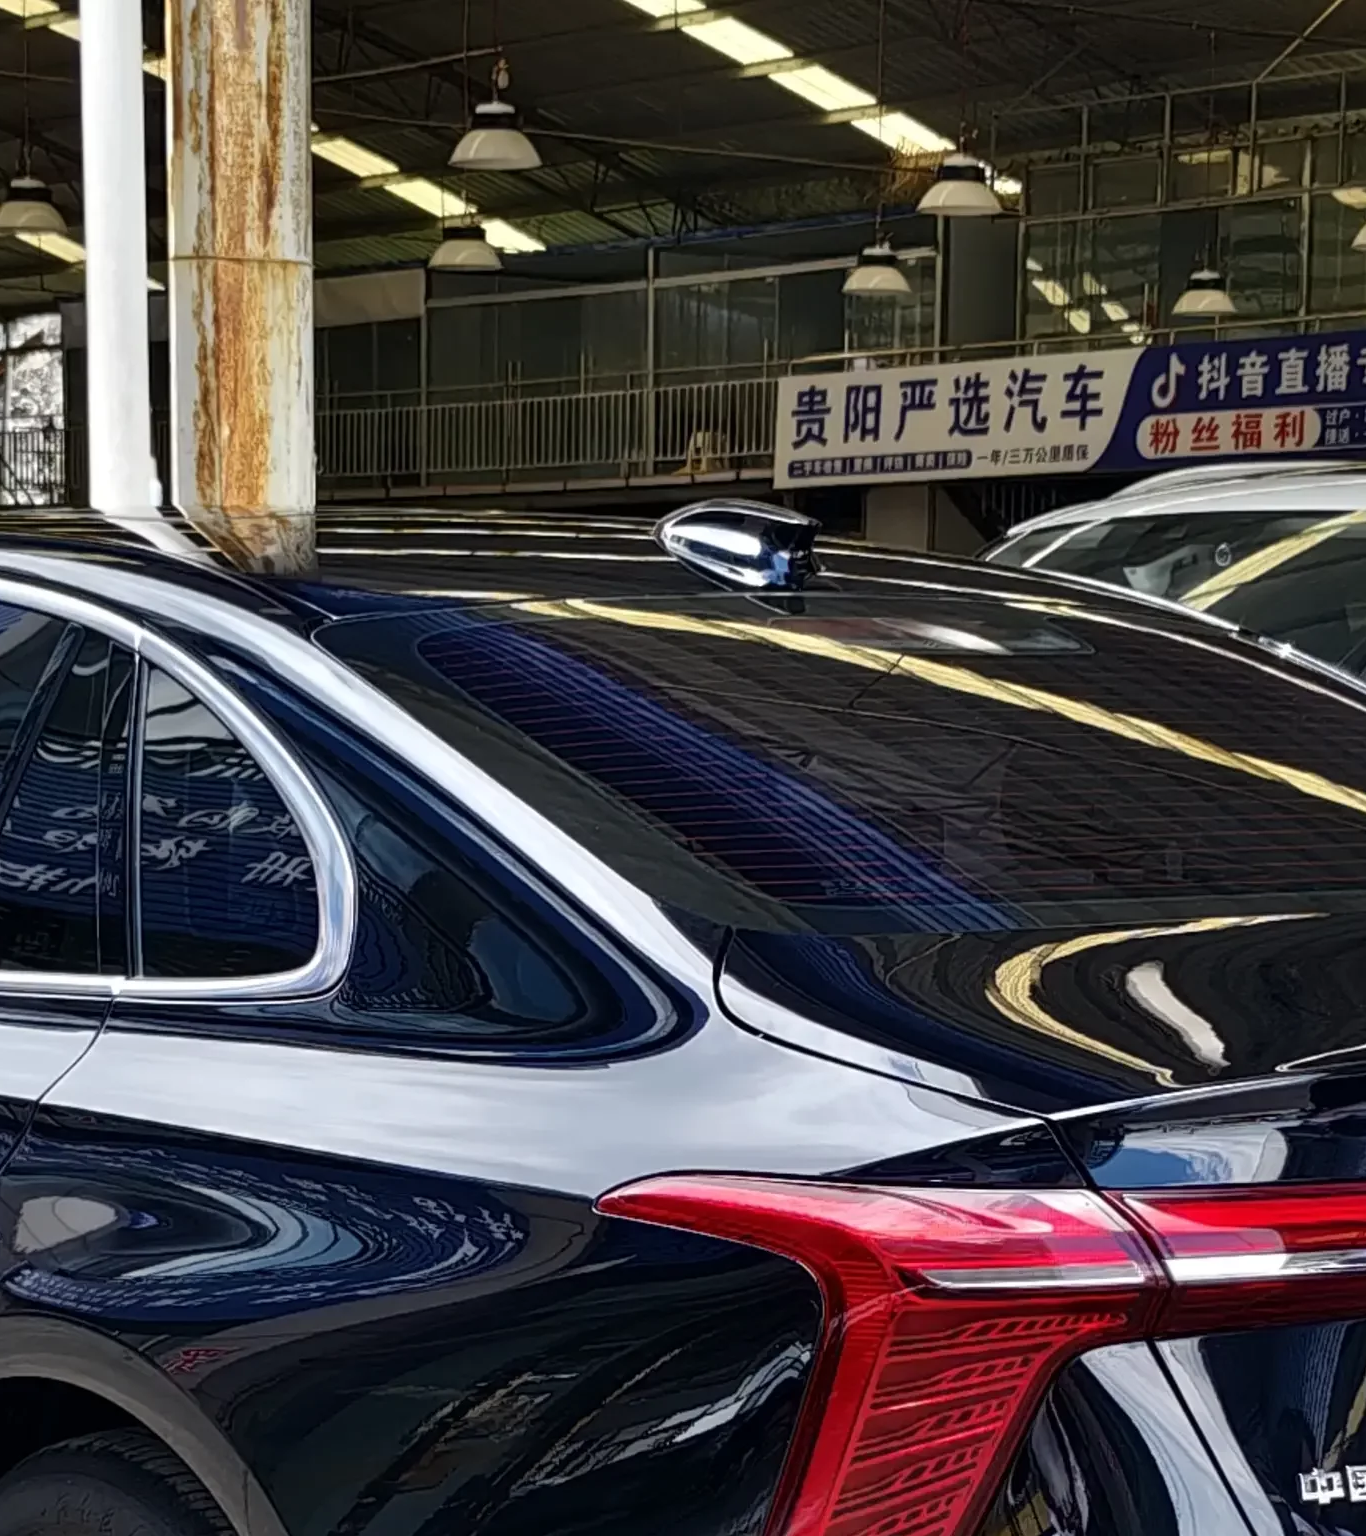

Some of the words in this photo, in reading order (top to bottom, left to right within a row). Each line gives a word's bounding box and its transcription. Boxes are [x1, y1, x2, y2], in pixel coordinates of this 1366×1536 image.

[791, 364, 1104, 449] 贵阳严选汽车
[1149, 410, 1305, 455] 粉丝福利
